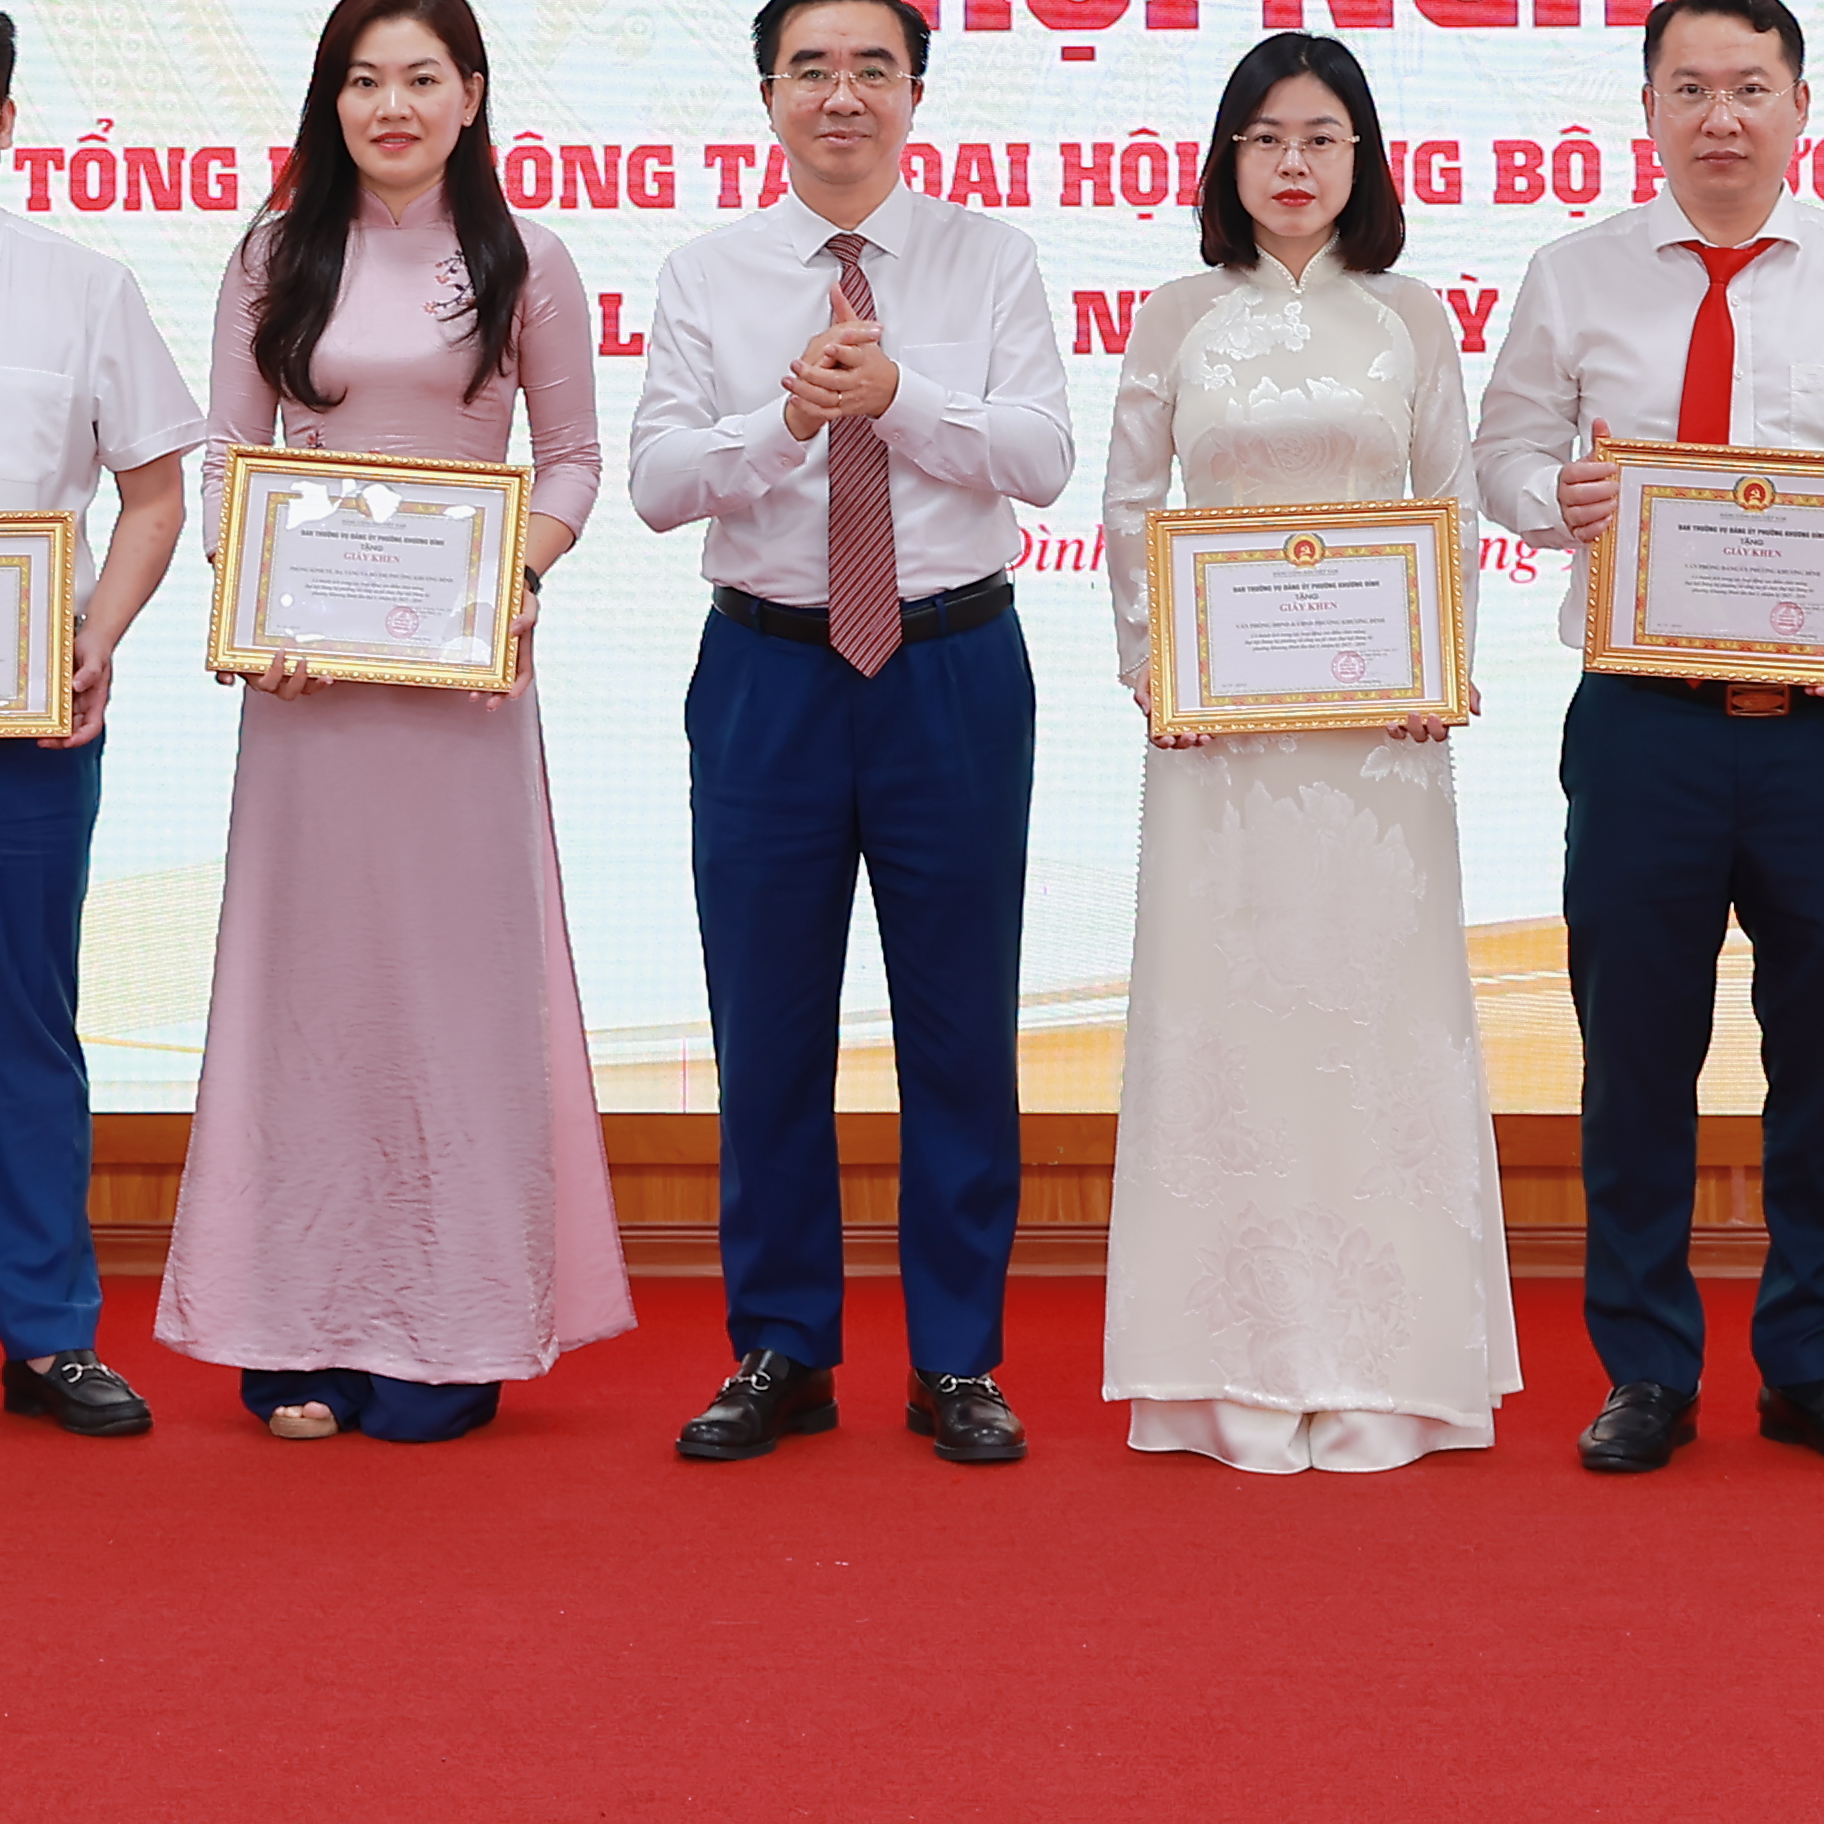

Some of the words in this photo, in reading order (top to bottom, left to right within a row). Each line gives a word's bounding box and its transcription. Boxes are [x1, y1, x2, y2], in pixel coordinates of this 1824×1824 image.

[13, 118, 238, 212] TỔNG
[490, 131, 676, 210] ÔNG
[1059, 127, 1200, 219] HỘI
[1493, 125, 1601, 217] BỘ
